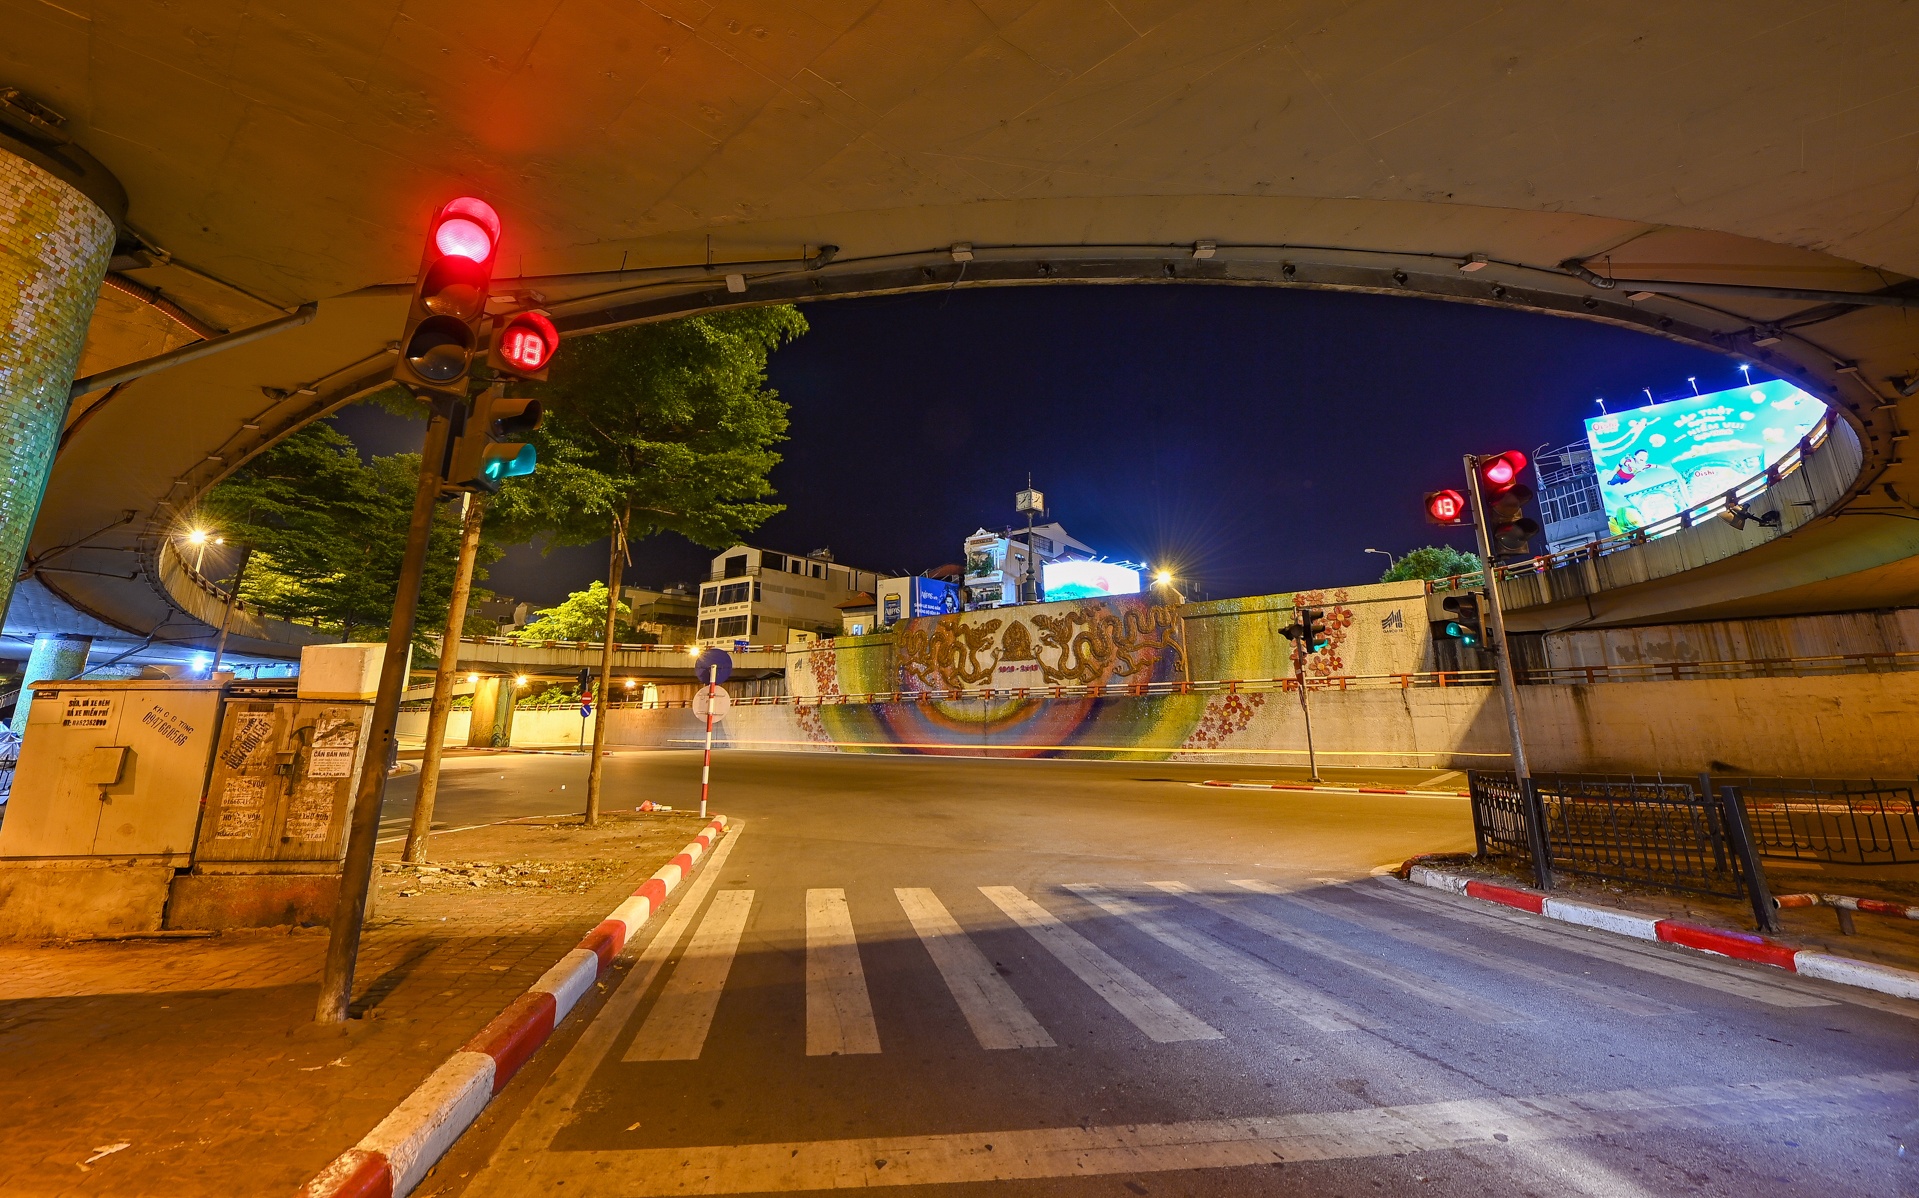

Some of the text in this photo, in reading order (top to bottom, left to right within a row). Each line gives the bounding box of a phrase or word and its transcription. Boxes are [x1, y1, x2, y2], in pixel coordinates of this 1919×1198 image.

[514, 333, 542, 365] 18
[1438, 498, 1455, 516] 18
[153, 705, 163, 713] KH
